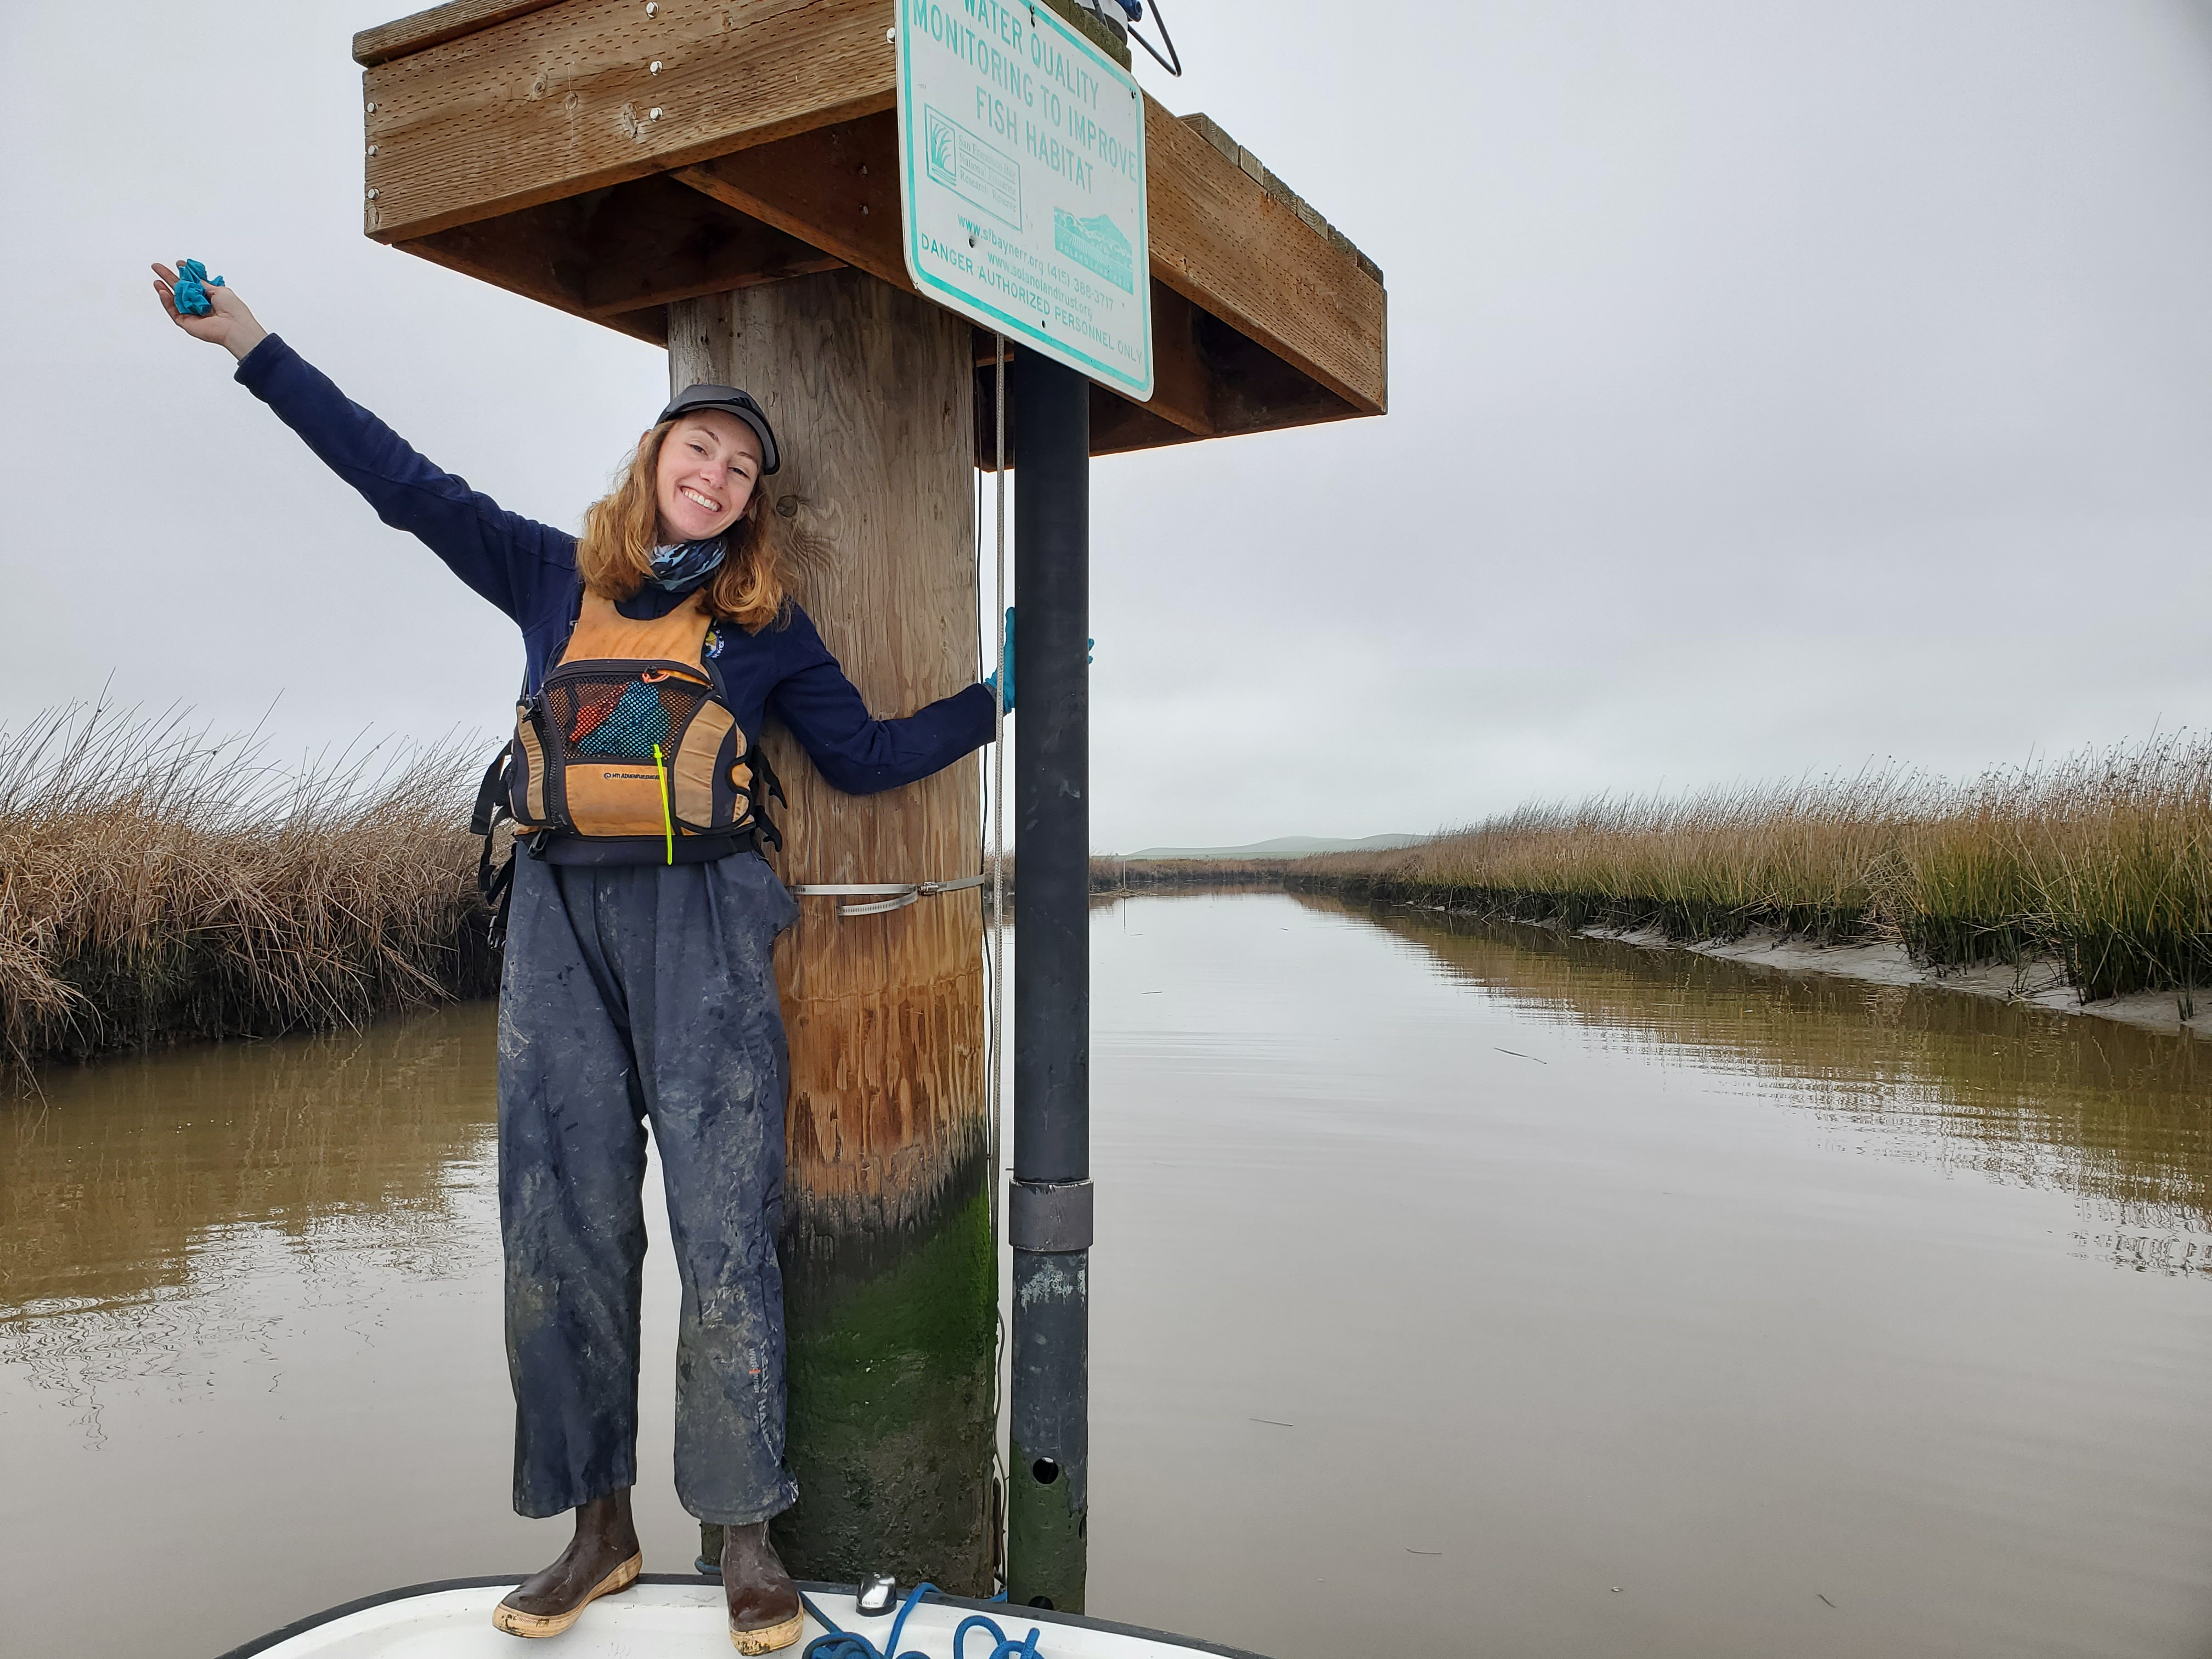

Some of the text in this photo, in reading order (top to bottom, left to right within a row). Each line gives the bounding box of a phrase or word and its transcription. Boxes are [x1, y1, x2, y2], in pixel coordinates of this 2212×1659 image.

[912, 0, 1137, 183] MONITORING TO IMPROVE
[1030, 32, 1098, 110] QUALITY
[958, 134, 971, 153] San
[1004, 163, 1016, 182] Bay
[959, 152, 986, 178] National
[976, 85, 1093, 194] FISH HABITAT
[960, 169, 1017, 212] Research Reserve
[957, 214, 1114, 312] www.sfbaynerr.org (415) 388-3717
[987, 251, 1092, 323] www.solanolandtrust.org
[1059, 242, 1089, 266] SOLANO
[921, 232, 1143, 364] DANGER AUTHORIZED PERSONNEL ONLY
